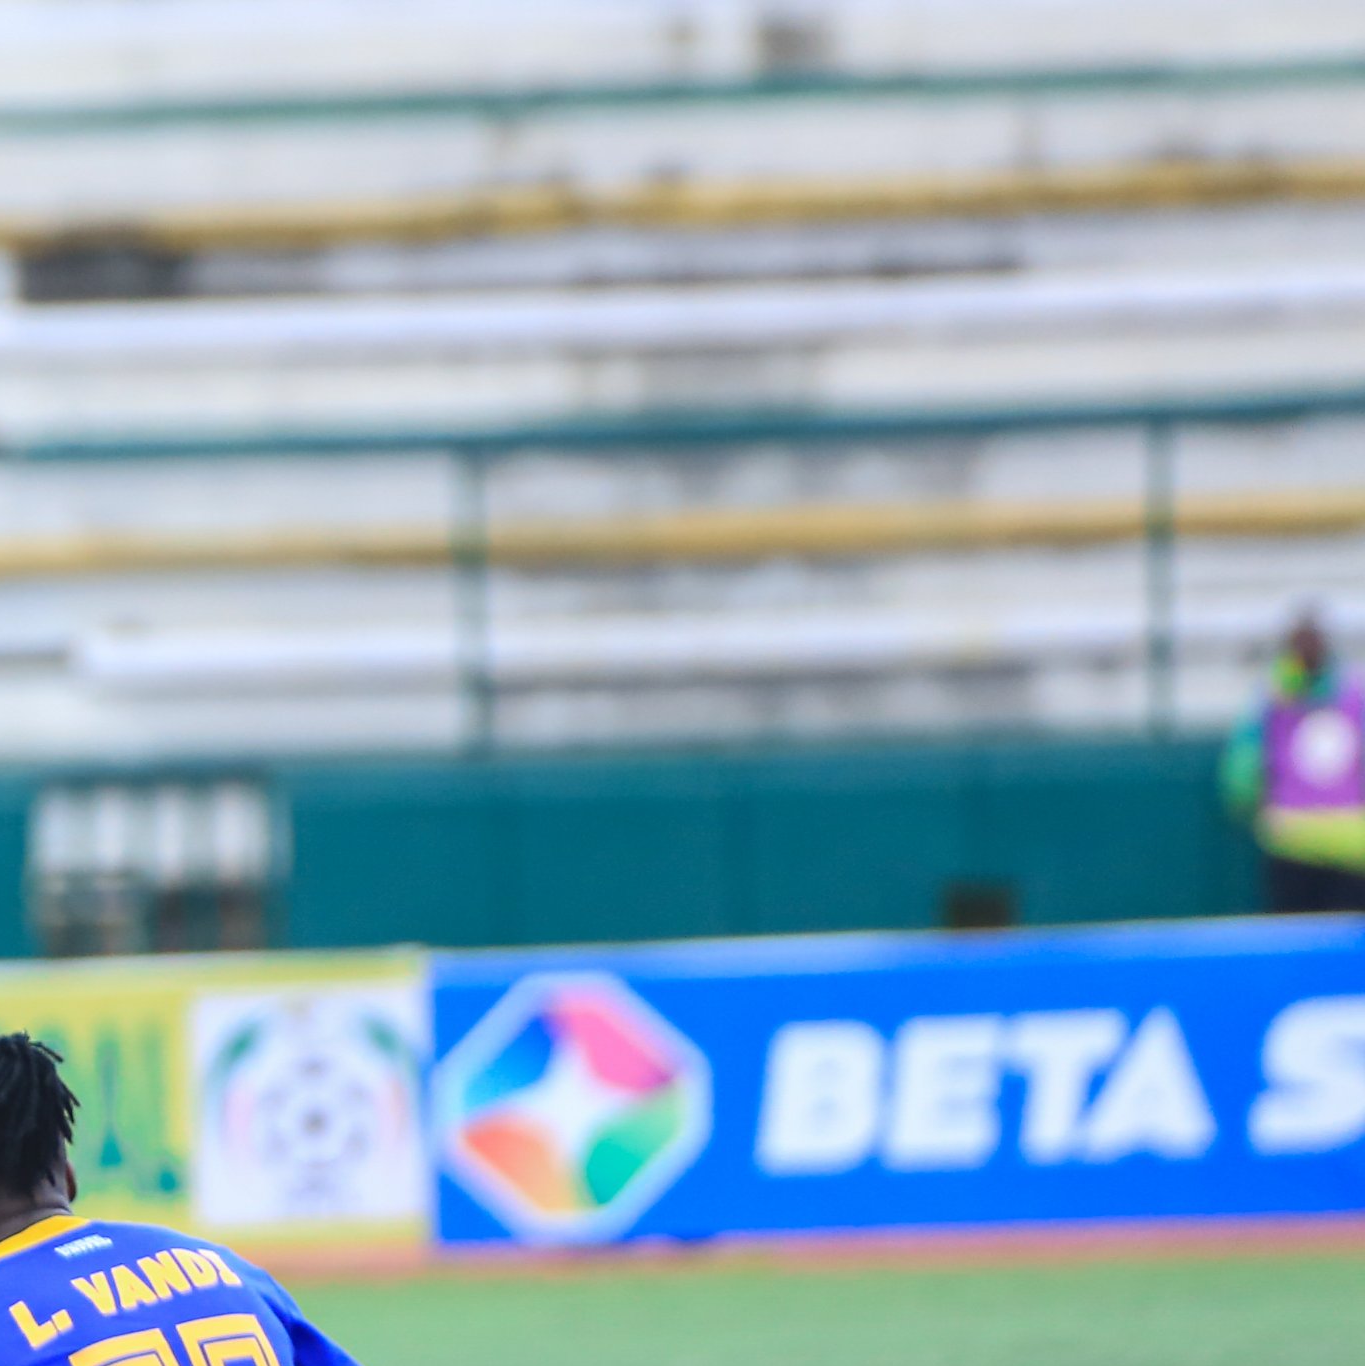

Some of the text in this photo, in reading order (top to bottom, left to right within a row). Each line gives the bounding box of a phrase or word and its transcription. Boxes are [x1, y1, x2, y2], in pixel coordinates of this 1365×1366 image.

[755, 1005, 1218, 1176] BETA
[9, 1248, 243, 1349] L. VANDI
